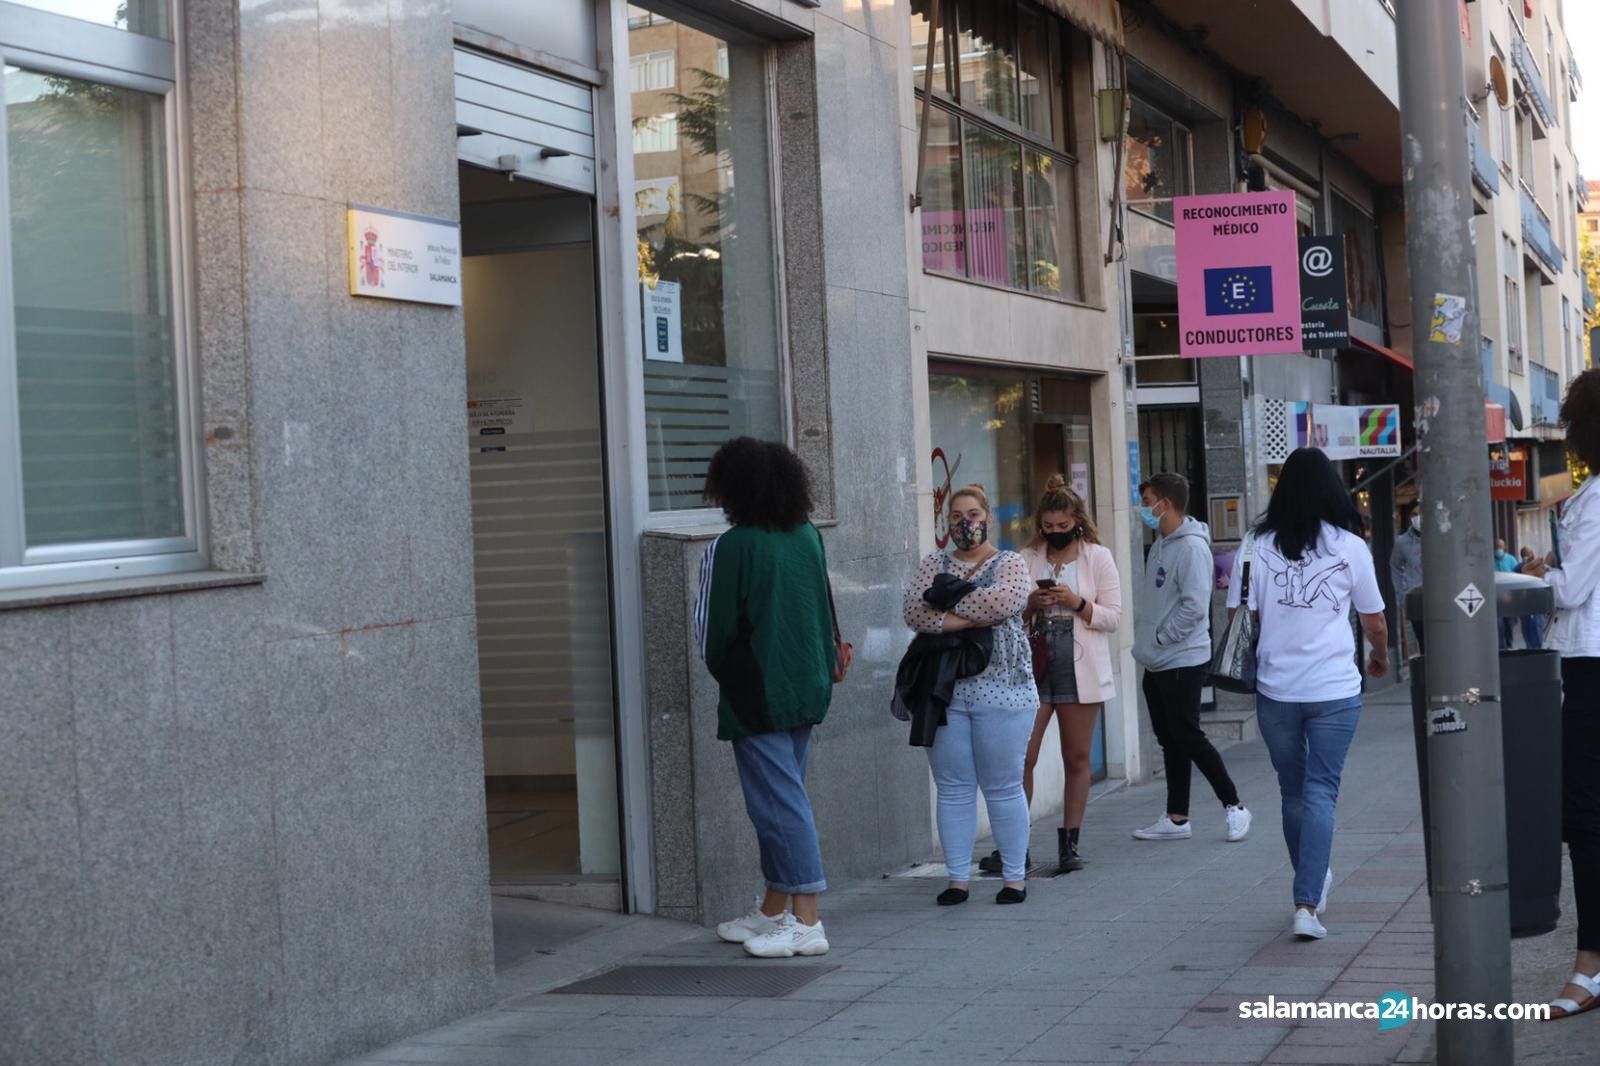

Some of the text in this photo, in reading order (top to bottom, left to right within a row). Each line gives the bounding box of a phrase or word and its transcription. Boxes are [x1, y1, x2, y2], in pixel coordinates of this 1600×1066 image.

[1183, 203, 1287, 220] RECONOCIMIENTO
[1213, 220, 1259, 236] MÉDICO
[1232, 282, 1246, 299] E
[1302, 296, 1340, 312] Cuesta
[1185, 326, 1295, 346] CONDUCTORES
[1308, 331, 1317, 339] de
[1318, 330, 1347, 339] Trámites
[1359, 446, 1398, 456] NAUTALIA
